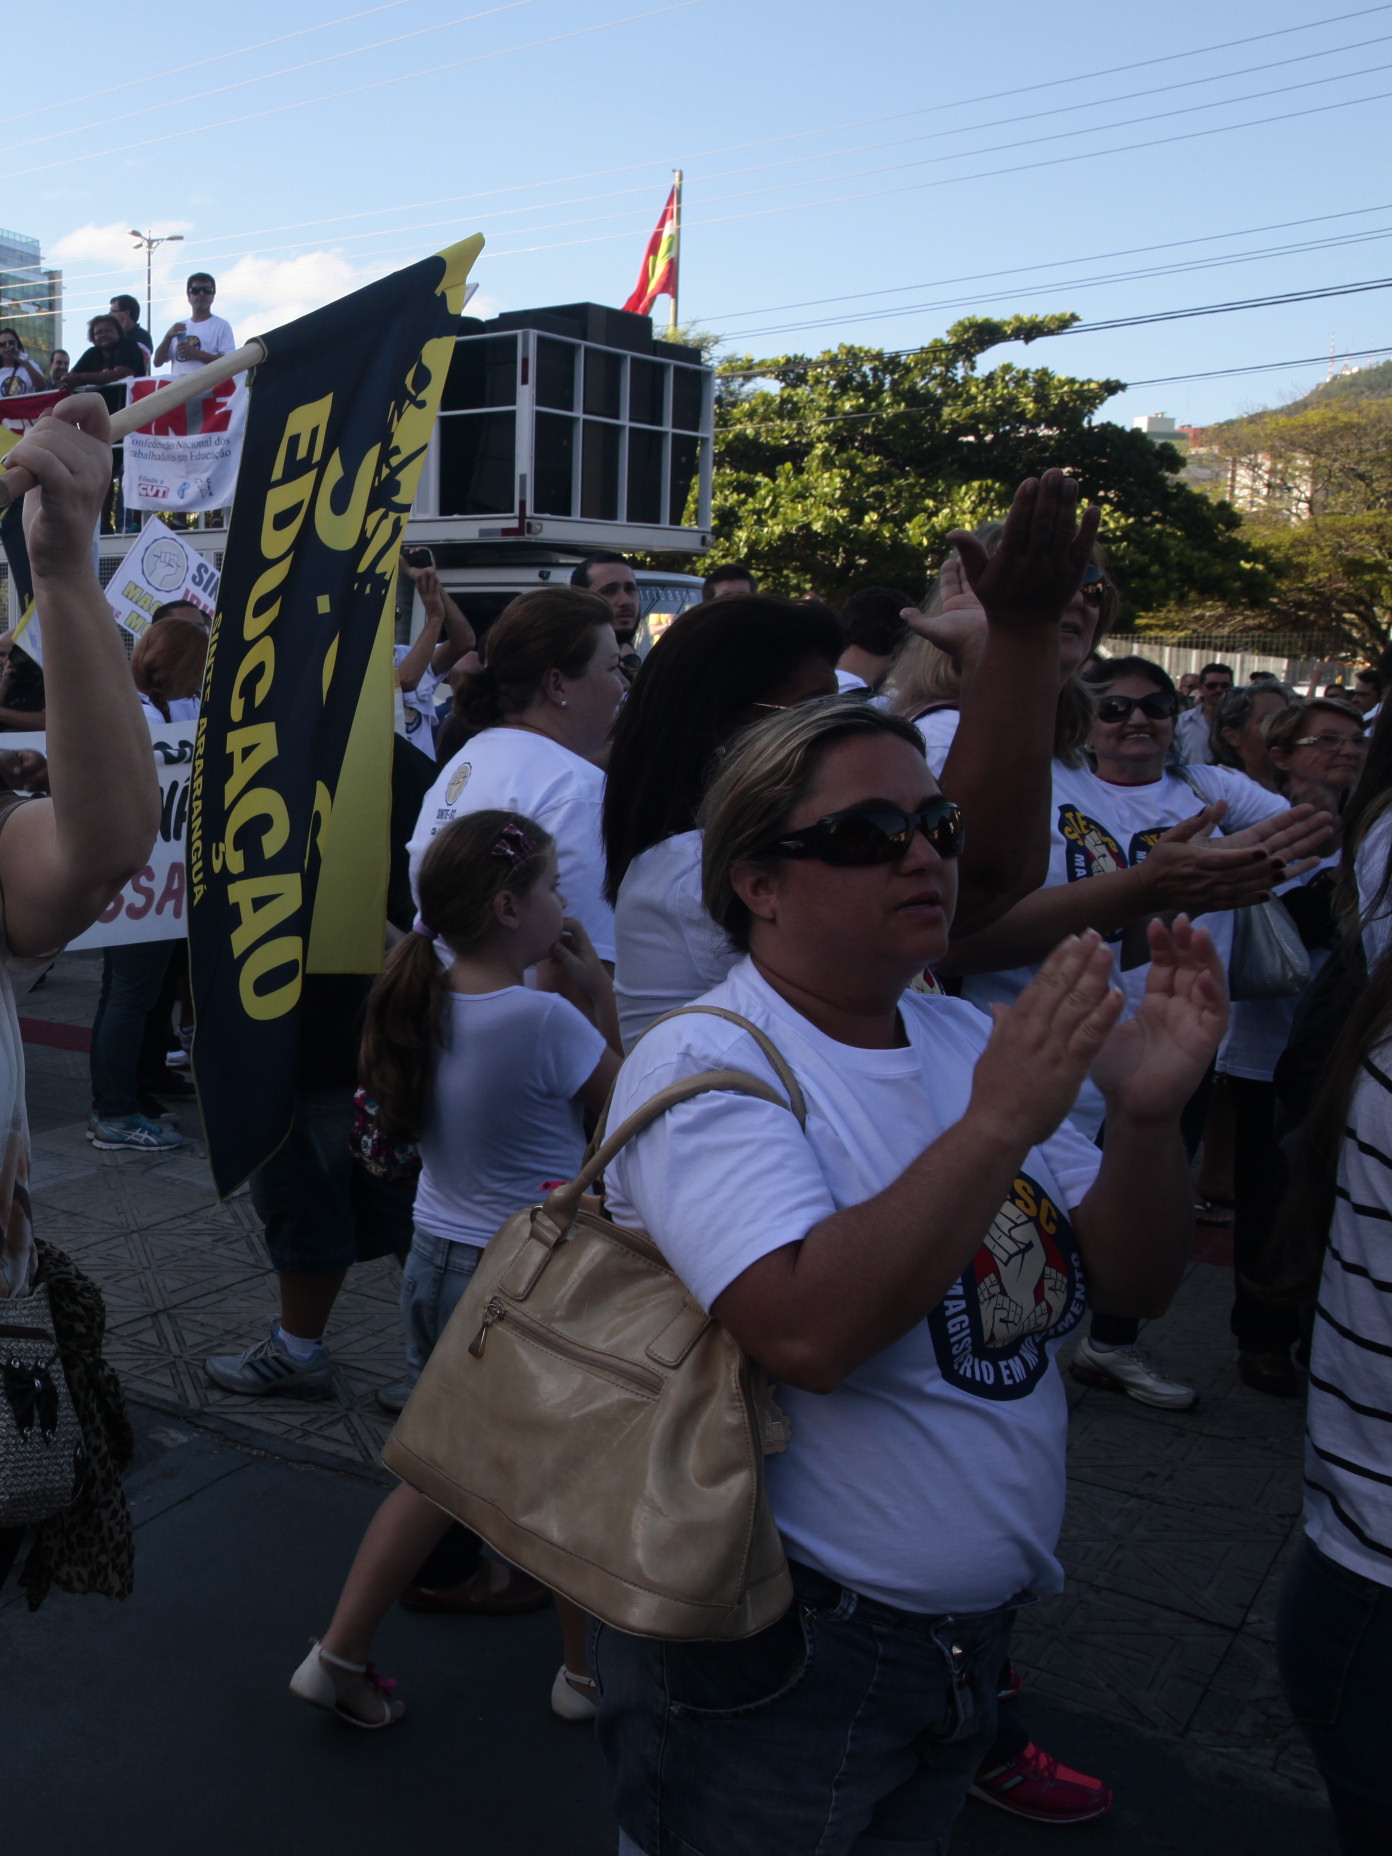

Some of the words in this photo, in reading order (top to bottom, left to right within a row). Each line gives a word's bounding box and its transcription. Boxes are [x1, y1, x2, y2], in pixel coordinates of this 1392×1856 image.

[130, 436, 175, 451] onfederação
[176, 438, 212, 451] Nacional
[214, 436, 231, 447] dos
[129, 450, 177, 463] rabalhadores
[177, 454, 188, 462] em
[190, 449, 232, 463] Educação
[138, 484, 167, 498] CUT
[191, 716, 209, 907] ARARANGUÁ
[997, 1357, 1028, 1386] EM
